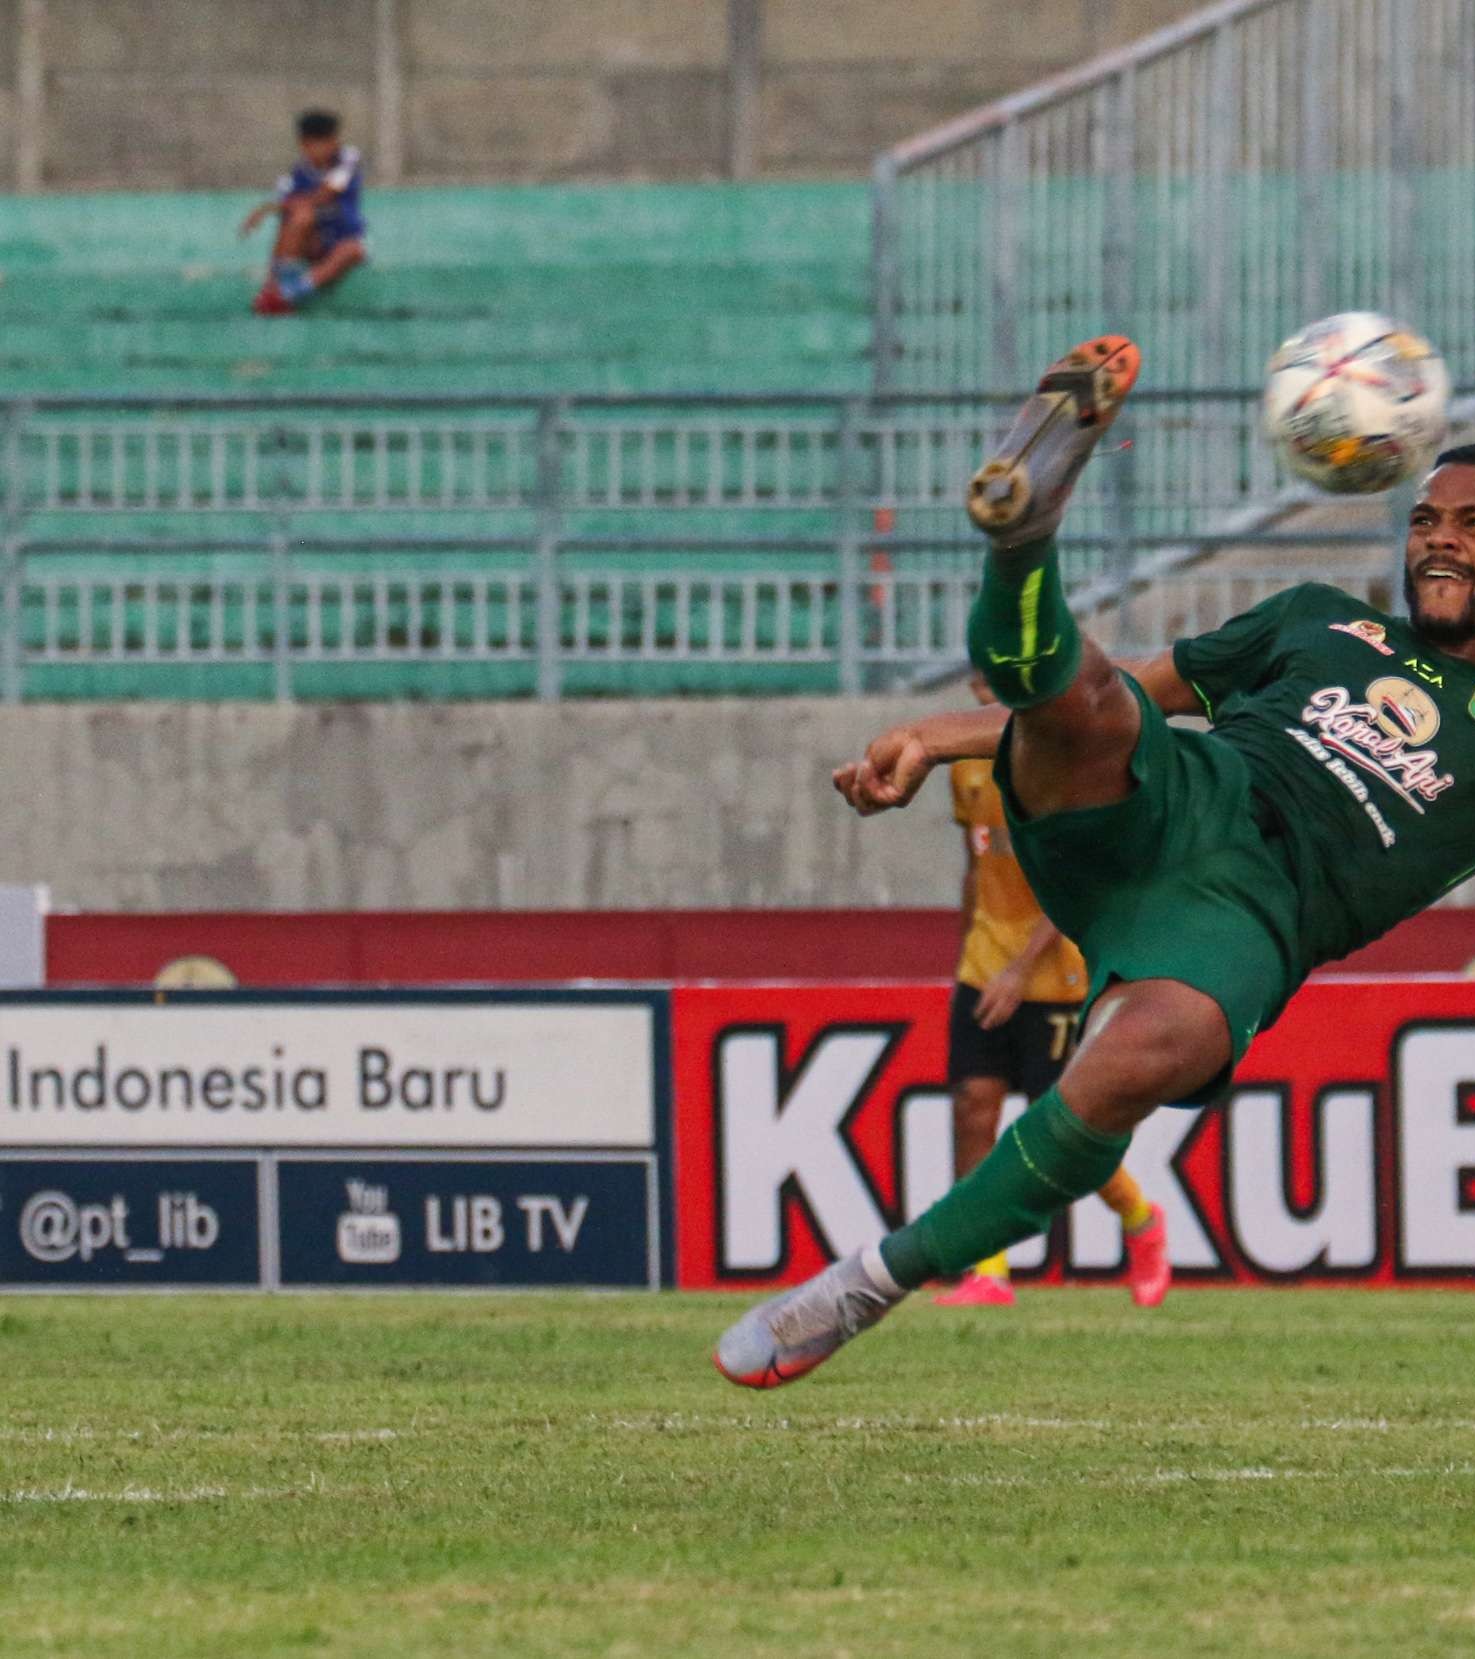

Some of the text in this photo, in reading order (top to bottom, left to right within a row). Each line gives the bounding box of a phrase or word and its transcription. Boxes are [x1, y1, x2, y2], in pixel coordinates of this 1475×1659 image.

[1302, 686, 1406, 760] Kapal
[1380, 750, 1455, 802] Api
[8, 1046, 506, 1111] Indonesia Baru
[20, 1190, 219, 1263] @pt_lib
[424, 1195, 589, 1252] LIB TV
